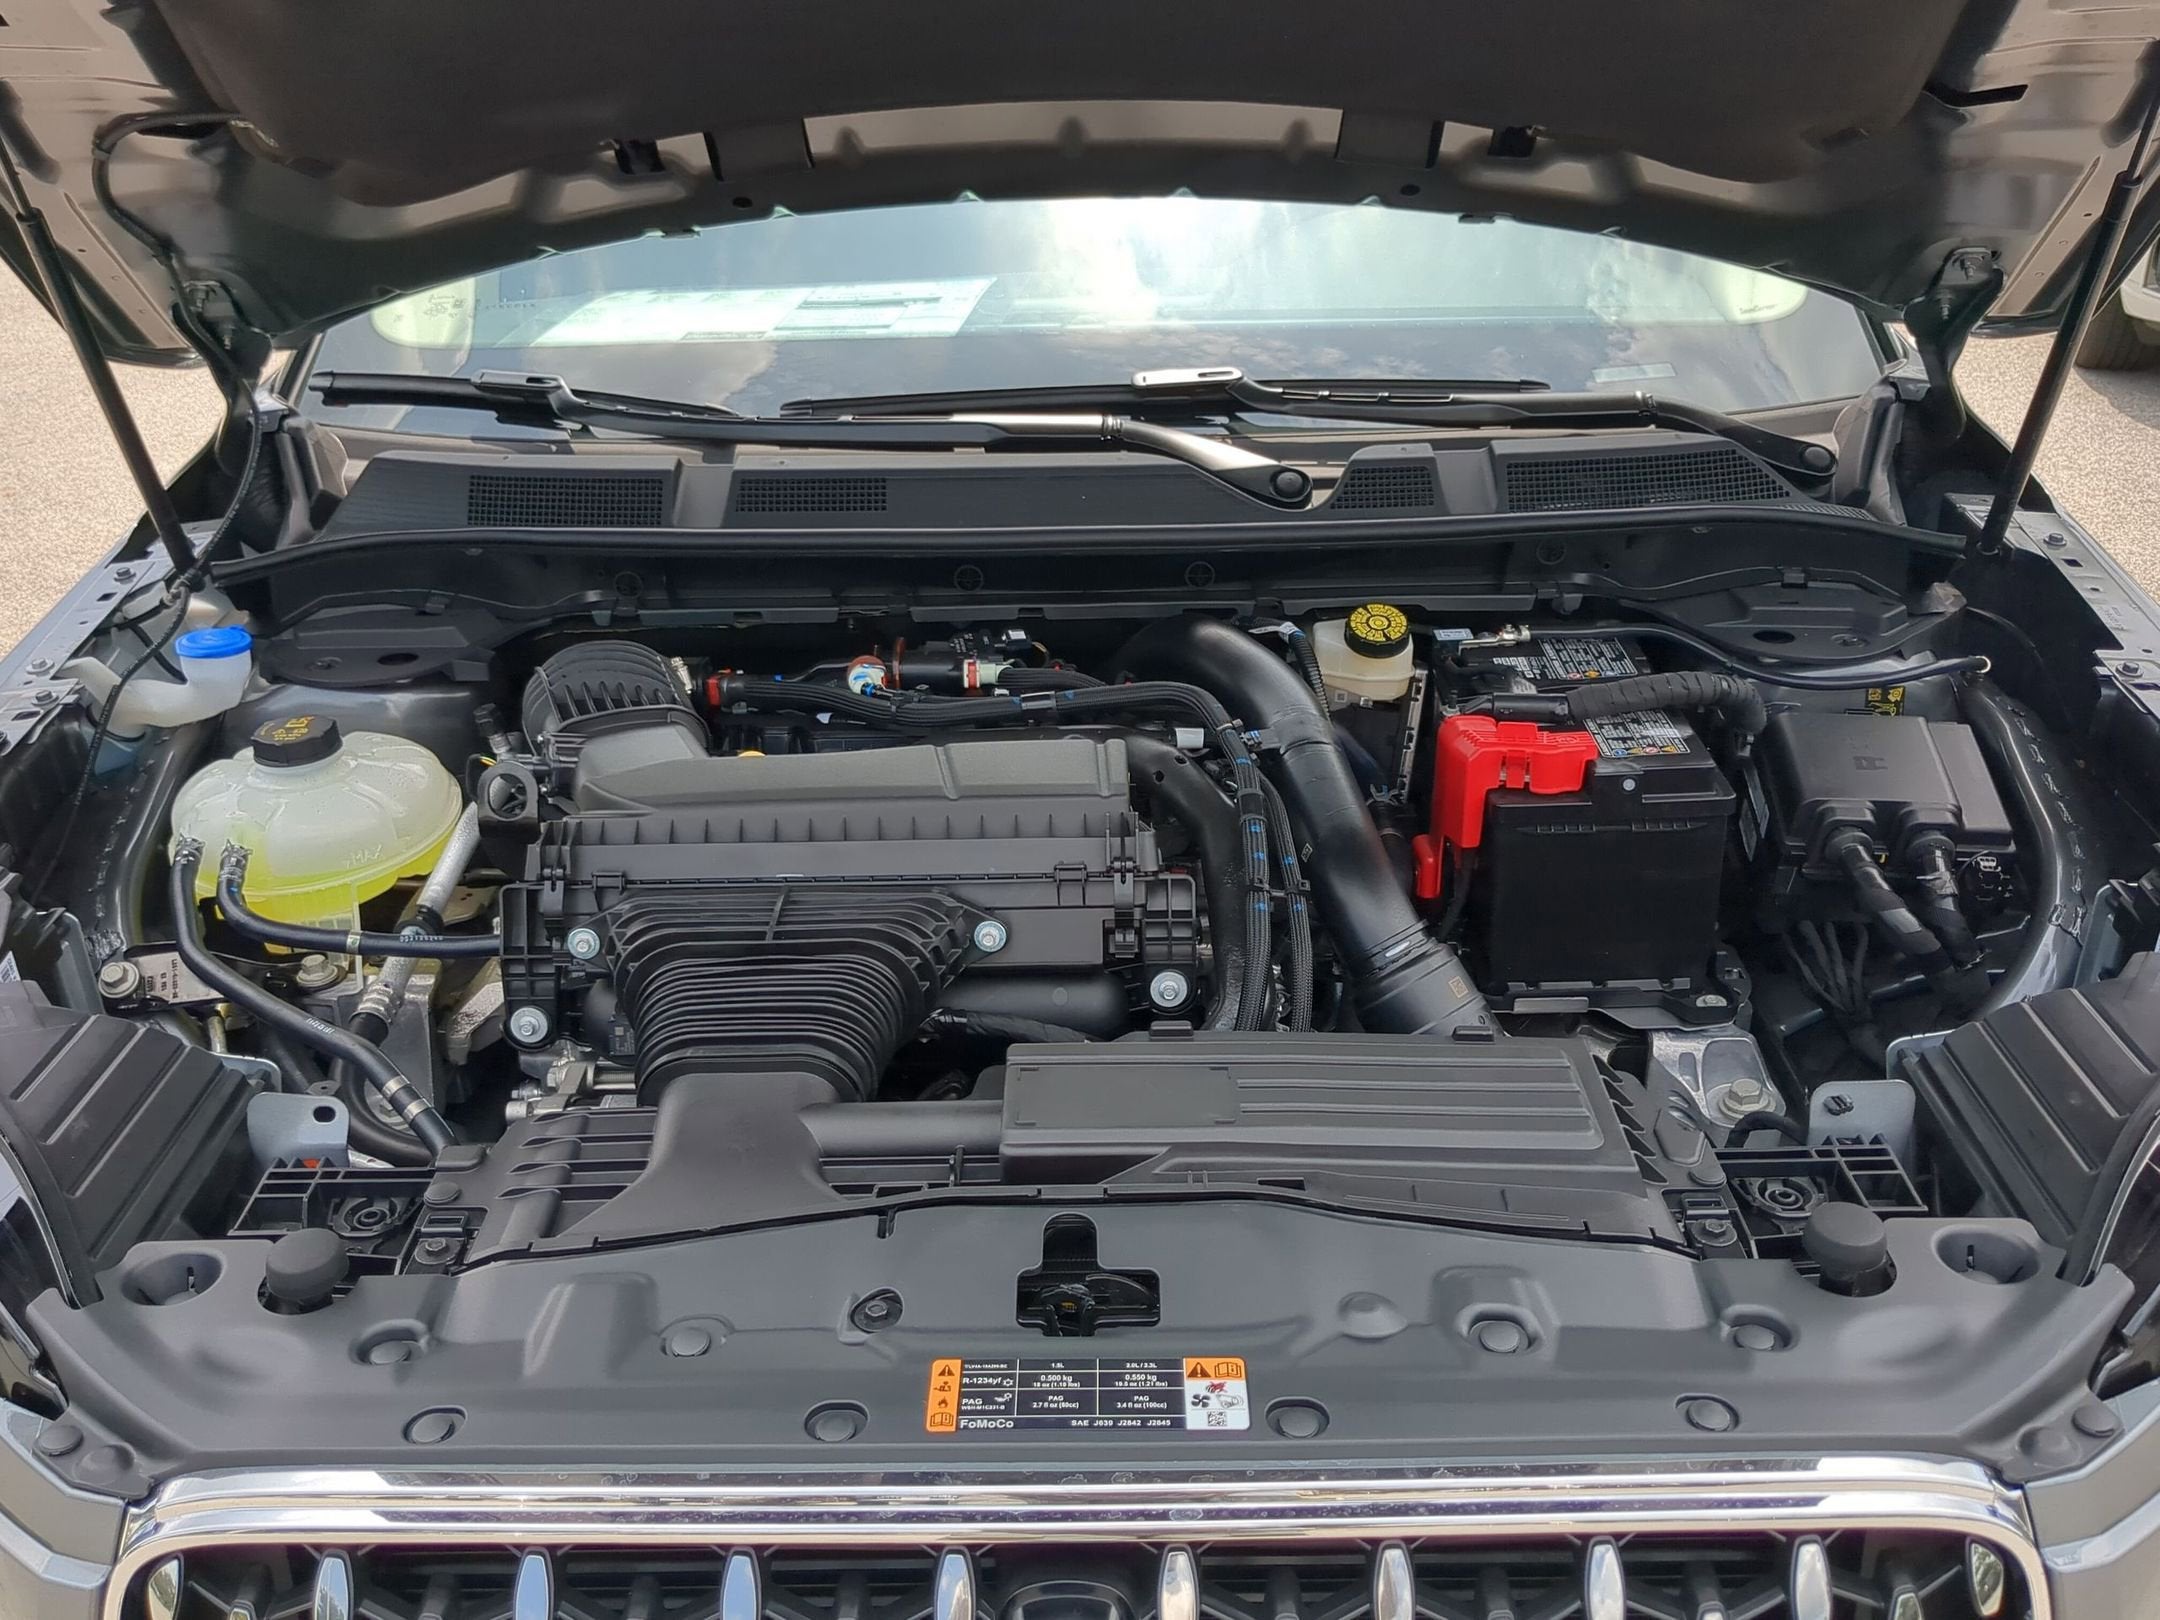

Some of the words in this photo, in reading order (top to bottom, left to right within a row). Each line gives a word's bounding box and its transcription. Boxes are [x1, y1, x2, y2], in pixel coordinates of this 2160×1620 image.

[962, 1376, 1002, 1386] R-1234yf
[1062, 1374, 1073, 1382] kg
[1125, 1373, 1146, 1381] 0.550
[1147, 1373, 1157, 1381] kg
[960, 1419, 1014, 1429] FoMoCo
